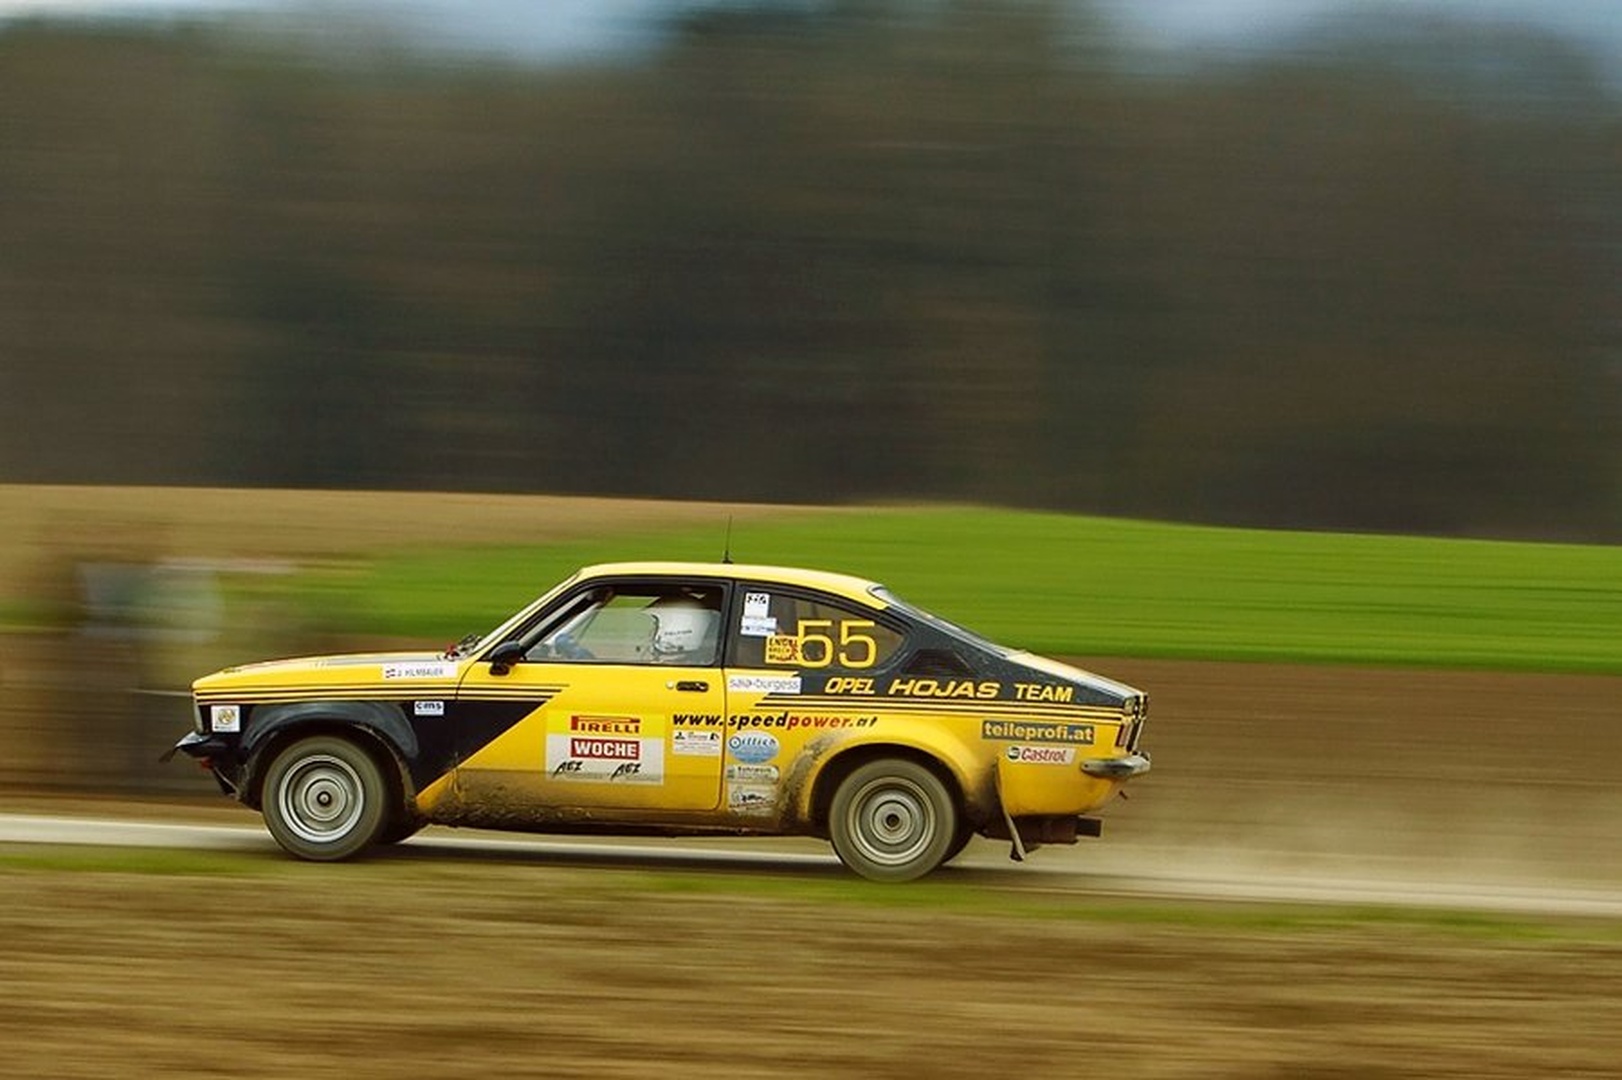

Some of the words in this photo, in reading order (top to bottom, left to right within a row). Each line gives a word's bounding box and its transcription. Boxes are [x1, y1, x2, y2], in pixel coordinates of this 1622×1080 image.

[798, 620, 876, 669] 55
[825, 677, 875, 694] OPEL
[888, 679, 1000, 698] HOJAS
[1014, 684, 1073, 702] TEAM
[571, 715, 641, 733] PIRELLI
[984, 722, 1093, 741] teileprofi.at
[574, 741, 638, 757] WOCHE
[1021, 747, 1067, 762] Castrol
